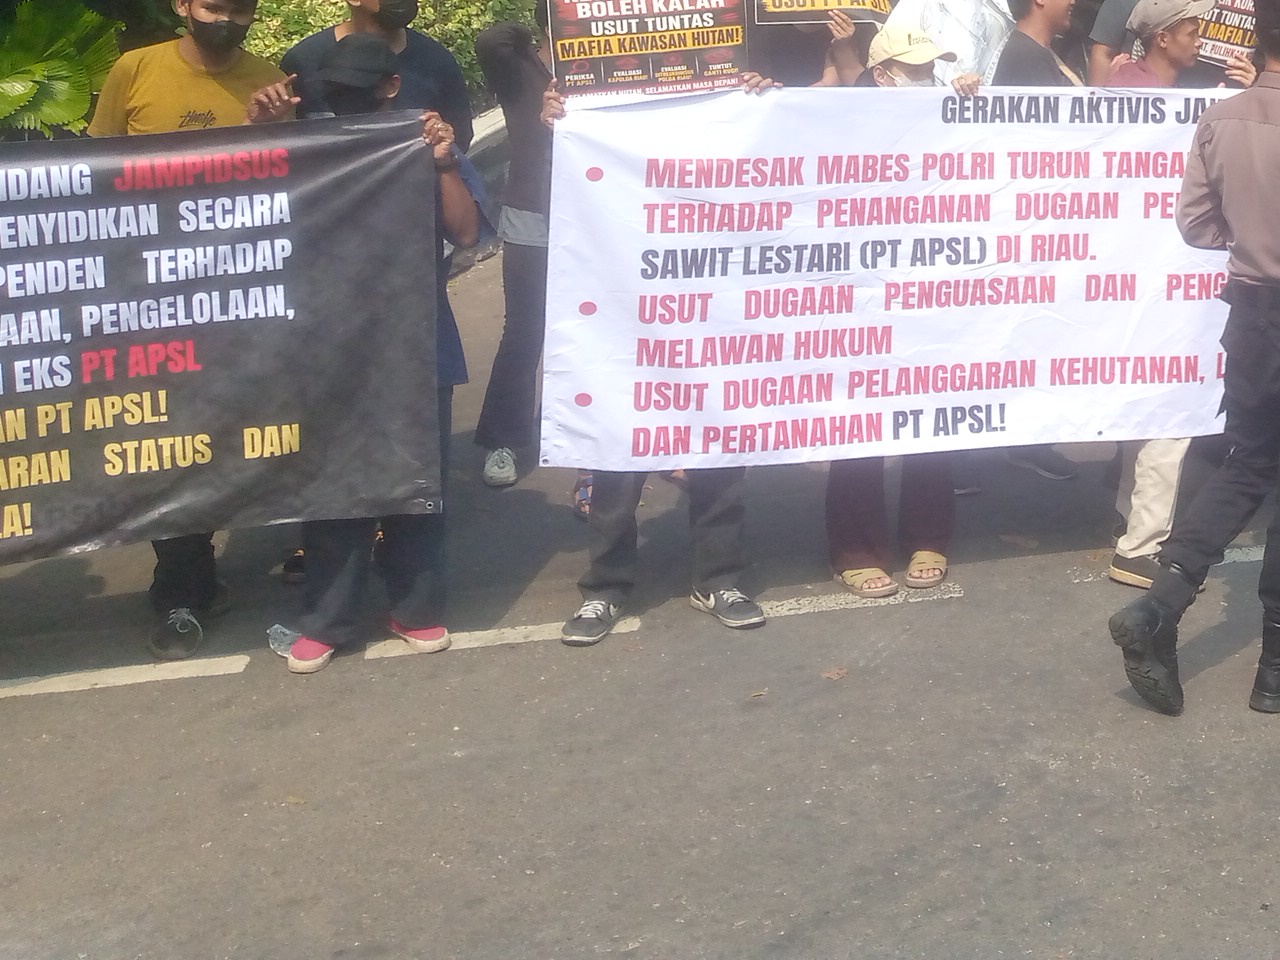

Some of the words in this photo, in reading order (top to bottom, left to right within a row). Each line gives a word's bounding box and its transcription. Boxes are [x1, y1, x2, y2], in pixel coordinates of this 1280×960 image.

[576, 0, 647, 19] BOLEH
[591, 18, 640, 37] USUT
[644, 12, 714, 32] TUNTAS
[560, 39, 614, 59] MAFIA
[618, 32, 688, 54] KAWASAN
[692, 27, 740, 47] HUTAN!
[1206, 23, 1242, 46] MAFIA
[565, 73, 595, 82] PERIKSA
[645, 83, 692, 94] SELAMATKAN
[693, 80, 713, 90] MASA
[714, 78, 740, 88] DEPAN!
[941, 95, 1059, 124] GERAKAN
[1069, 96, 1166, 124] AKTIVIS
[114, 148, 290, 191] JAMPIDSUS
[645, 156, 805, 189] MENDESAK
[816, 153, 910, 185] MABES
[921, 152, 995, 182] POLRI
[1007, 151, 1090, 180] TURUN
[178, 192, 291, 232] SECARA
[643, 201, 792, 234] TERHADAP
[817, 193, 991, 229] PENANGANAN
[1014, 192, 1119, 221] DUGAAN
[143, 238, 292, 284] TERHADAP
[640, 246, 734, 281] SAWIT
[742, 241, 850, 276] LESTARI
[859, 238, 901, 271] (PT
[910, 236, 987, 269] APSL)
[996, 235, 1026, 265] DI
[1031, 232, 1097, 262] RIAU.
[81, 284, 296, 337] PENGELOLAAN,
[638, 292, 713, 326] USUT
[744, 285, 854, 320] DUGAAN
[883, 275, 1056, 312] PENGUASAAN
[1085, 273, 1136, 303] DAN
[14, 355, 72, 393] EKS
[81, 348, 115, 384] PT
[127, 340, 202, 376] APSL
[636, 331, 784, 370] MELAWAN
[794, 325, 893, 361] HUKUM
[634, 381, 709, 413] USUT
[723, 373, 834, 411] DUGAAN
[847, 359, 1036, 402] PELANGGARAN
[1050, 355, 1206, 387] KEHUTANAN,
[37, 401, 72, 438] PT
[84, 389, 168, 431] APSL!
[631, 425, 691, 458] DAN
[702, 412, 883, 455] PERTANAHAN
[893, 409, 922, 441] PT
[932, 402, 1007, 437] APSL!
[103, 434, 213, 477] STATUS
[243, 423, 300, 460] DAN
